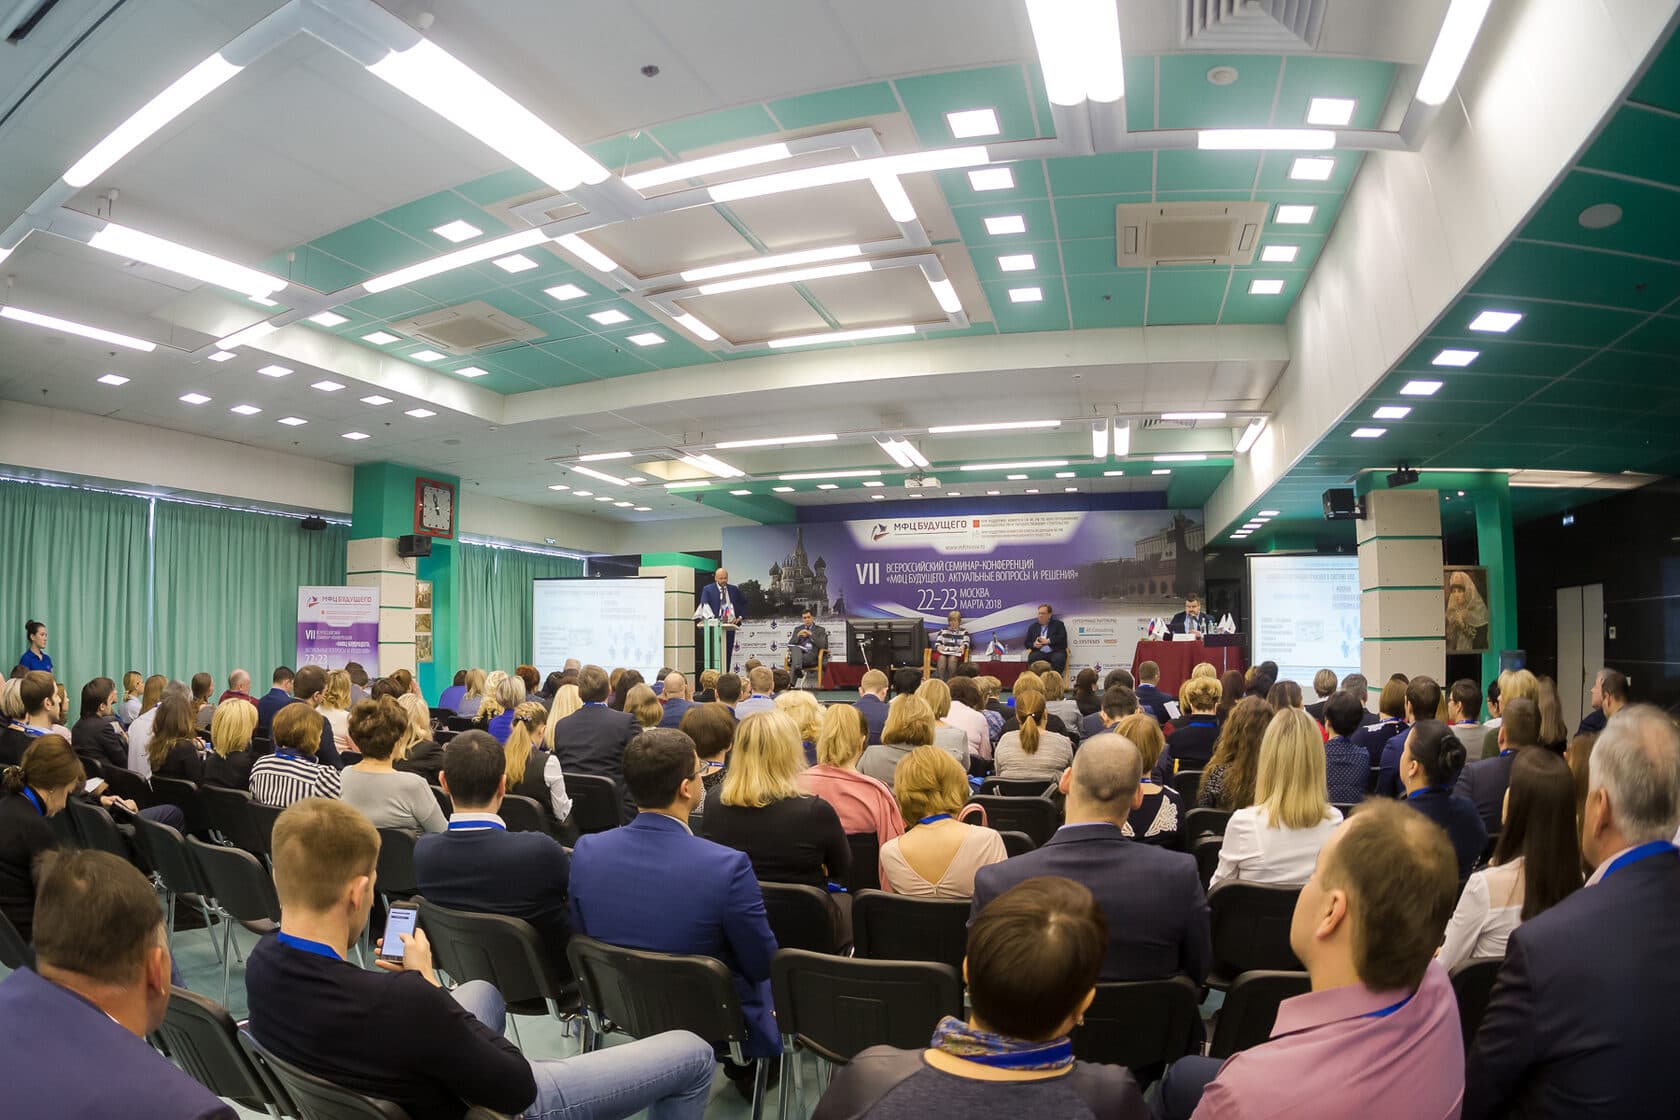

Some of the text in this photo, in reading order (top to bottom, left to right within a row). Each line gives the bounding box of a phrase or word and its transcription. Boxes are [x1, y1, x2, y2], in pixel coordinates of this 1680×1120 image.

[886, 559, 1034, 573] ВСЕРОССИЙСКИЙ СЕМИНАР-КОНФЕРЕНЦИЯ
[855, 563, 880, 585] VII
[948, 571, 995, 582] АКТУАЛЬНЫЕ
[995, 571, 1031, 581] ВОПРОСЫ
[1032, 570, 1039, 580] И
[959, 587, 990, 598] МОСКВА
[959, 599, 1002, 609] МАРТА 2018
